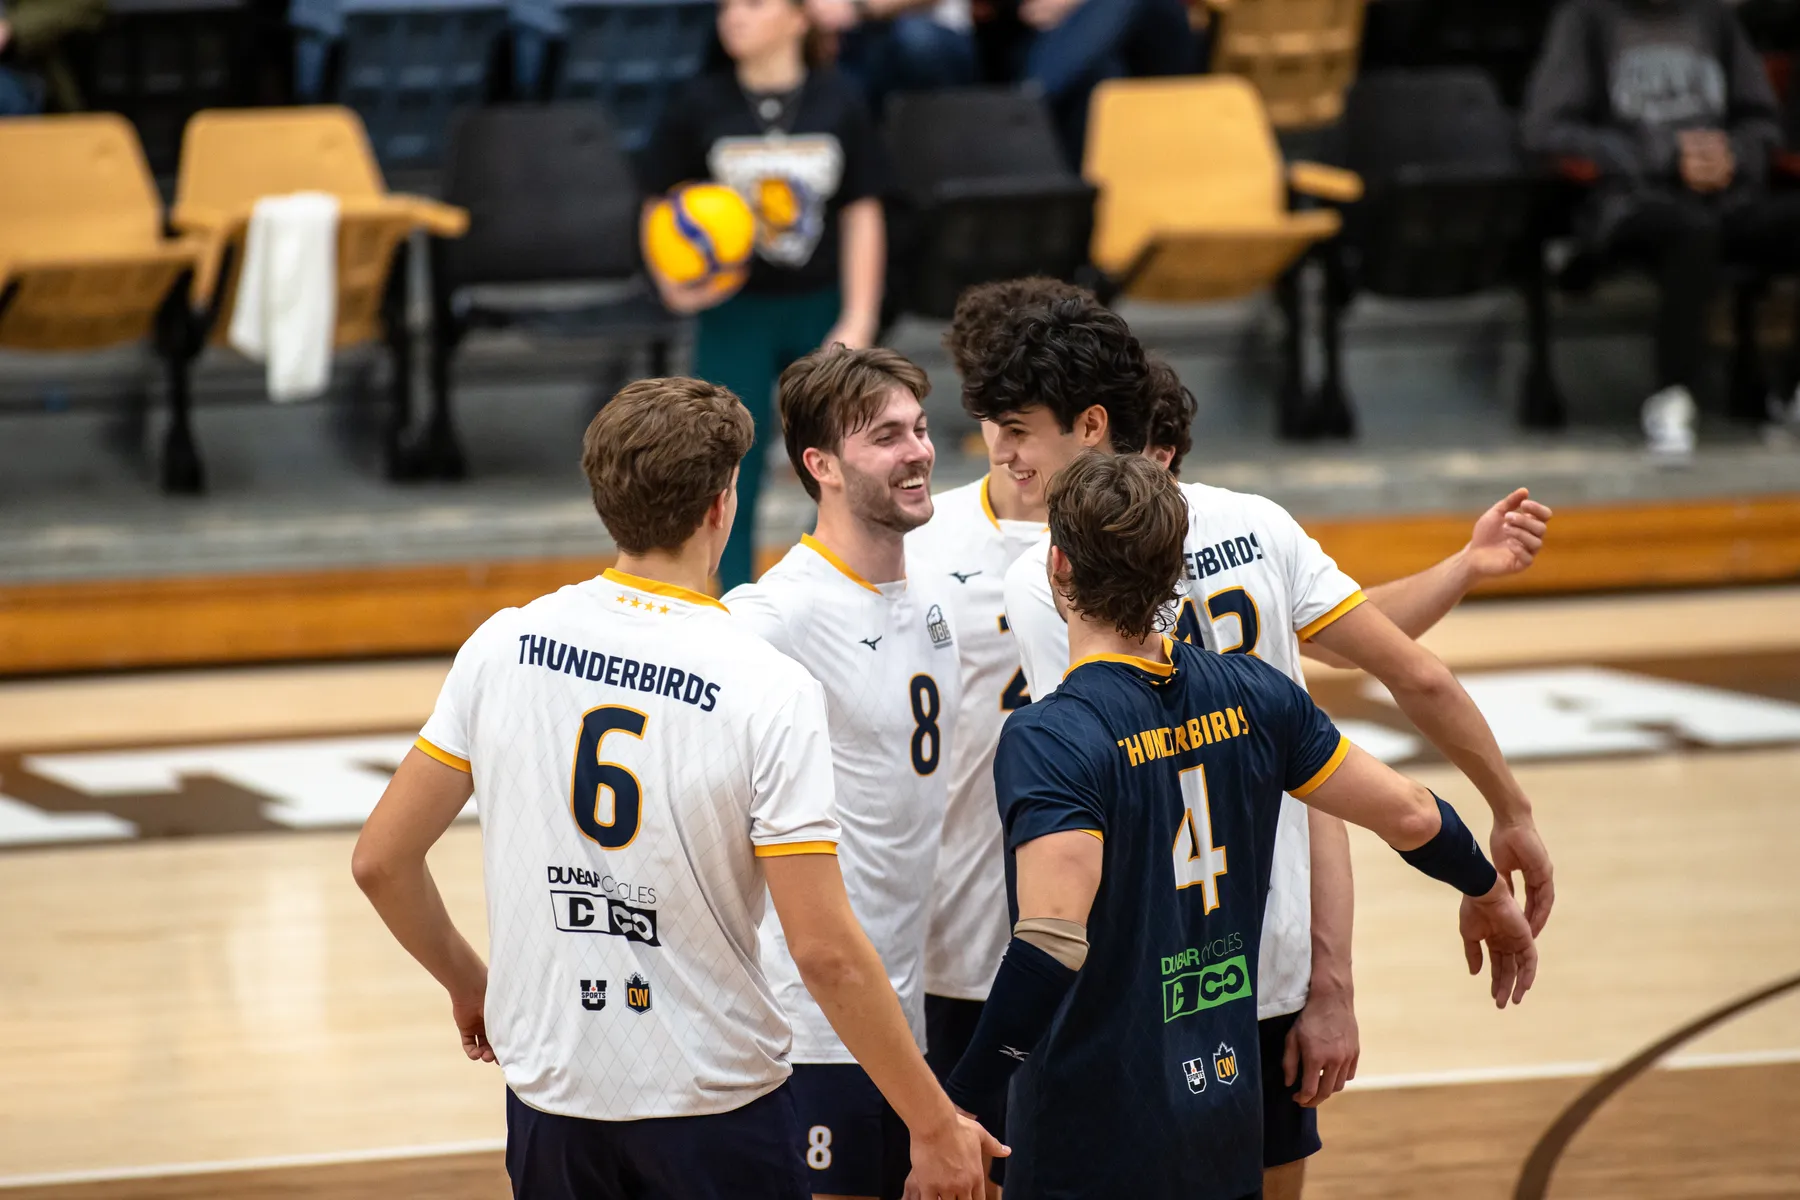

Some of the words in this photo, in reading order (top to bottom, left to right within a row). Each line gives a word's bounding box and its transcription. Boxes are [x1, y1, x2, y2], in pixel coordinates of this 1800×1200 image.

[518, 634, 721, 712] THUNDERBIRDS
[909, 672, 941, 777] 8
[569, 703, 649, 851] 6
[1172, 763, 1228, 916] 4
[628, 987, 649, 1008] CW
[1217, 1056, 1235, 1078] CW
[806, 1125, 832, 1170] 8
